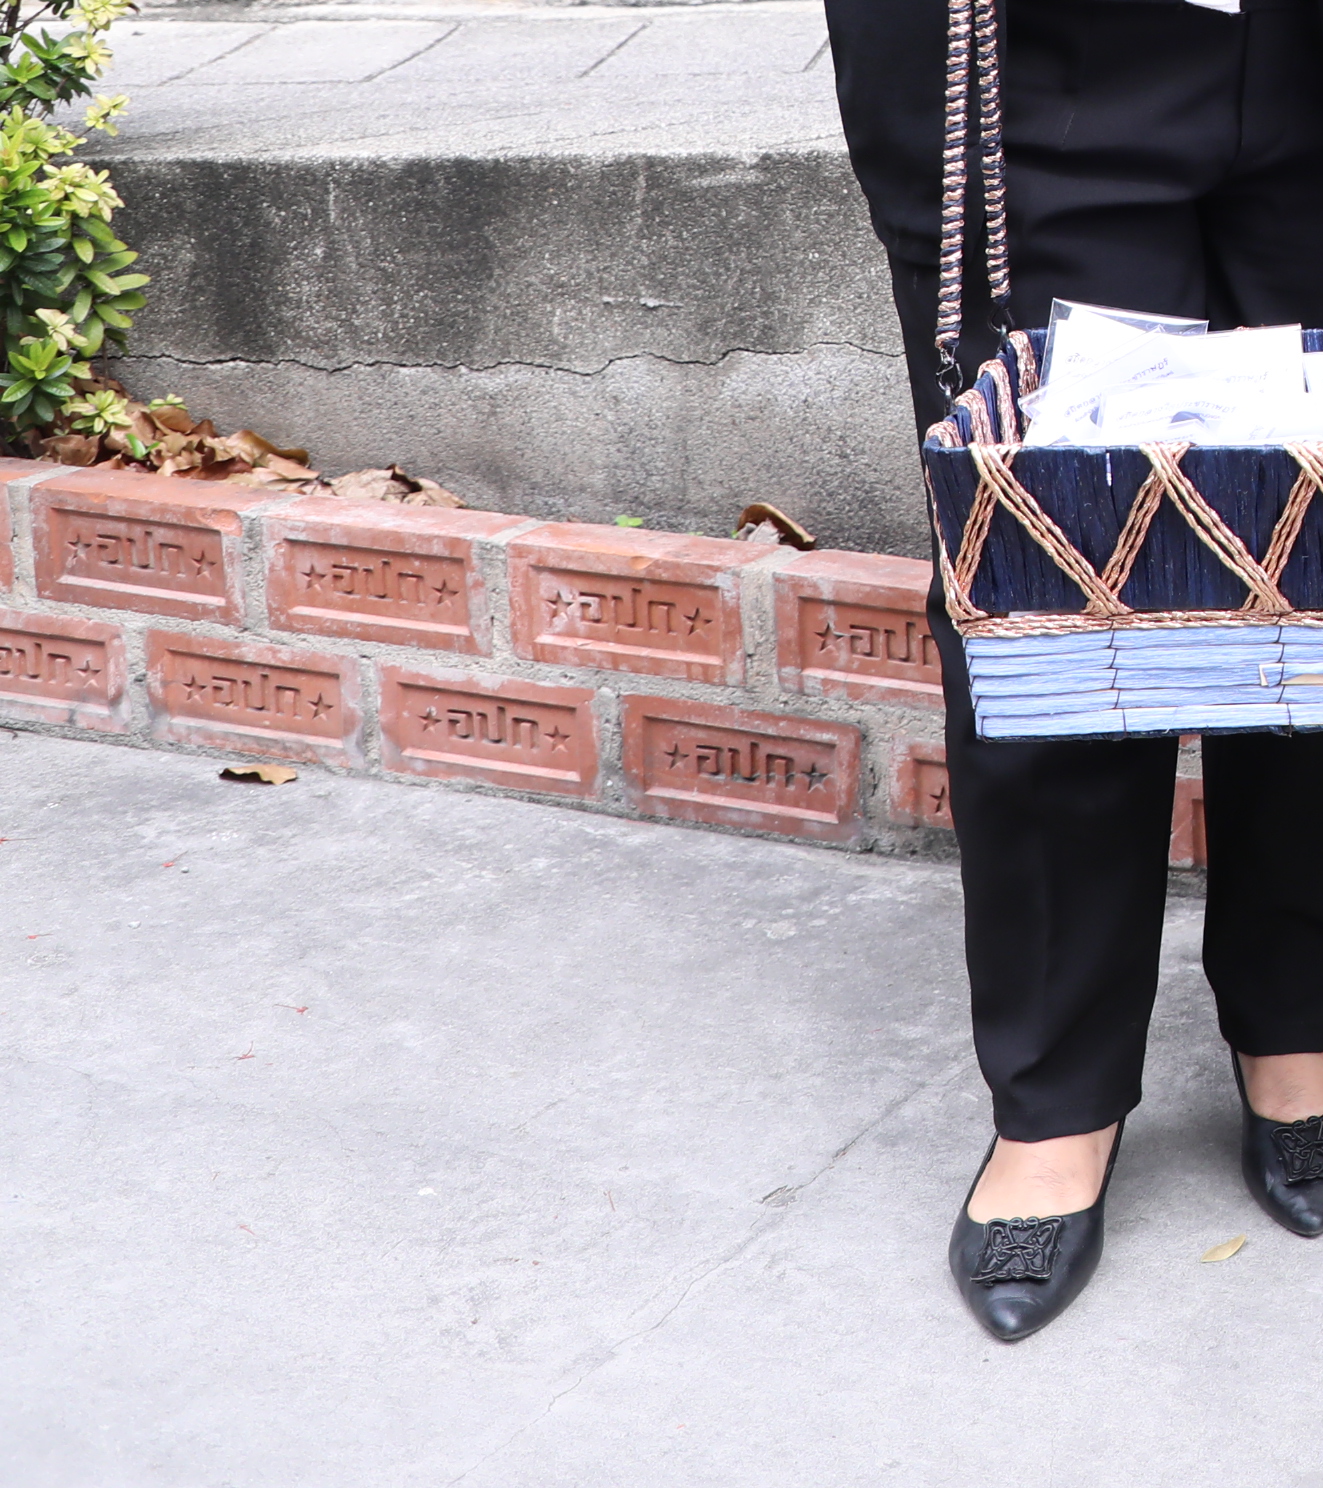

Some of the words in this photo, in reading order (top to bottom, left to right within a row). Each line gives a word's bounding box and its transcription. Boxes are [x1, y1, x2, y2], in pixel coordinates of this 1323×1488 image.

[96, 531, 186, 577] อปก
[331, 559, 426, 606] อปก
[578, 588, 677, 634] อปก
[211, 674, 302, 719] อปก
[447, 705, 540, 751] อปก
[696, 741, 796, 791] อปก
